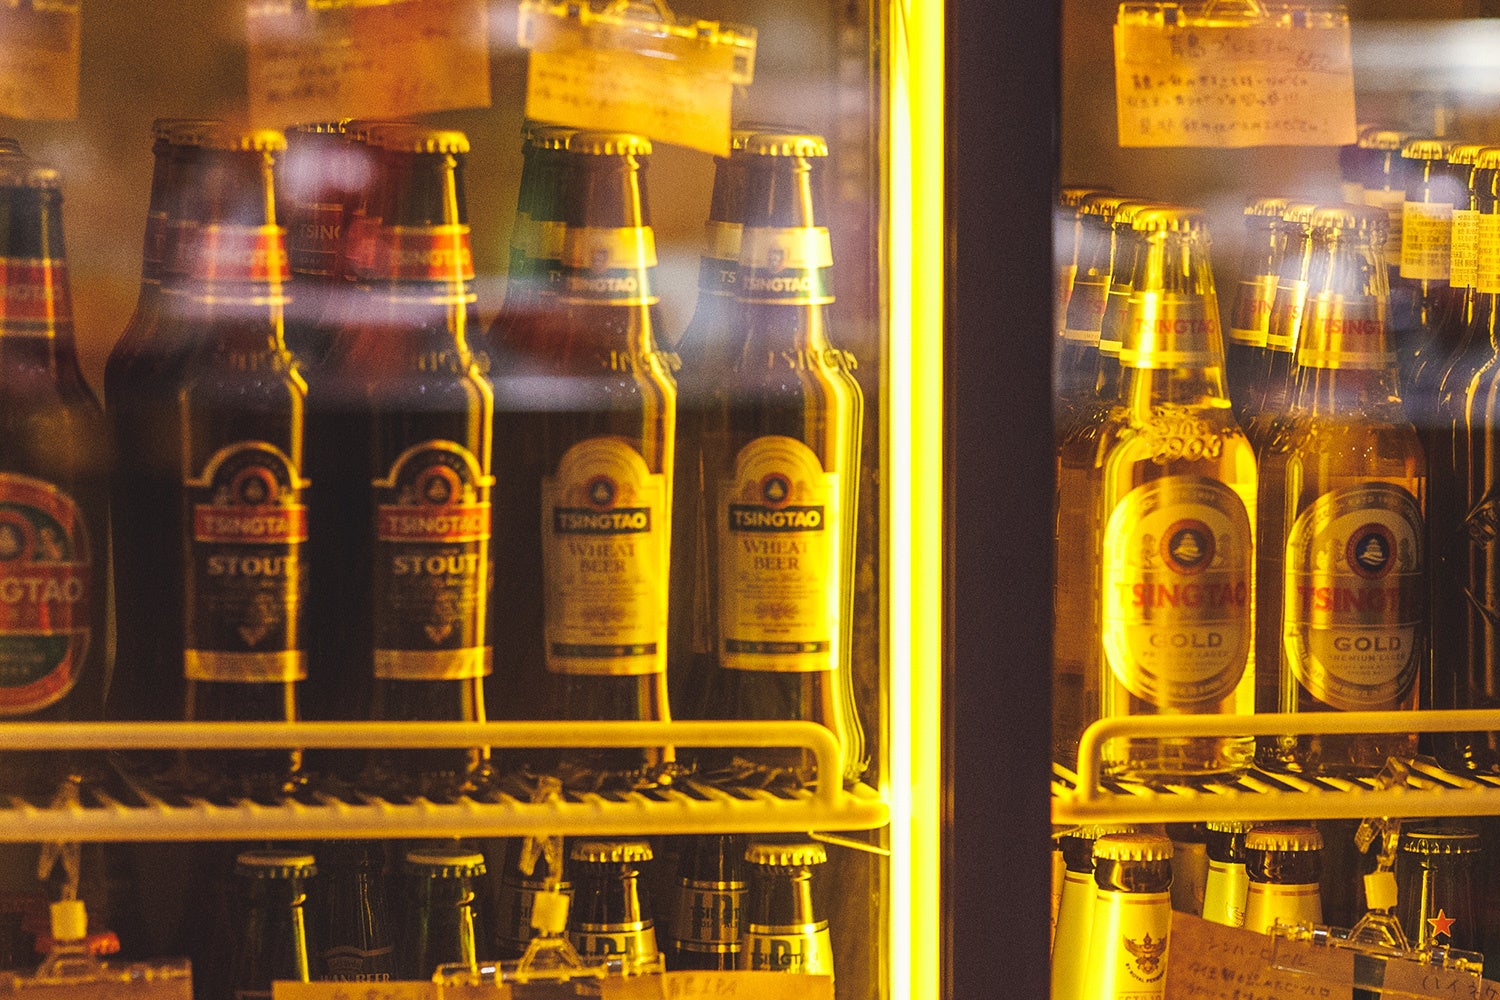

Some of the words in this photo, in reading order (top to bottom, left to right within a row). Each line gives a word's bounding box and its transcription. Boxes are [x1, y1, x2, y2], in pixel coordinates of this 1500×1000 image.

[558, 513, 648, 530] TSINGTAO
[733, 510, 822, 528] TSINGTAO
[207, 555, 299, 575] STOUT
[393, 555, 478, 575] STOUT
[579, 558, 627, 574] BEER
[753, 556, 800, 571] BEER
[1149, 633, 1224, 649] GOLD
[1333, 636, 1402, 652] GOLD
